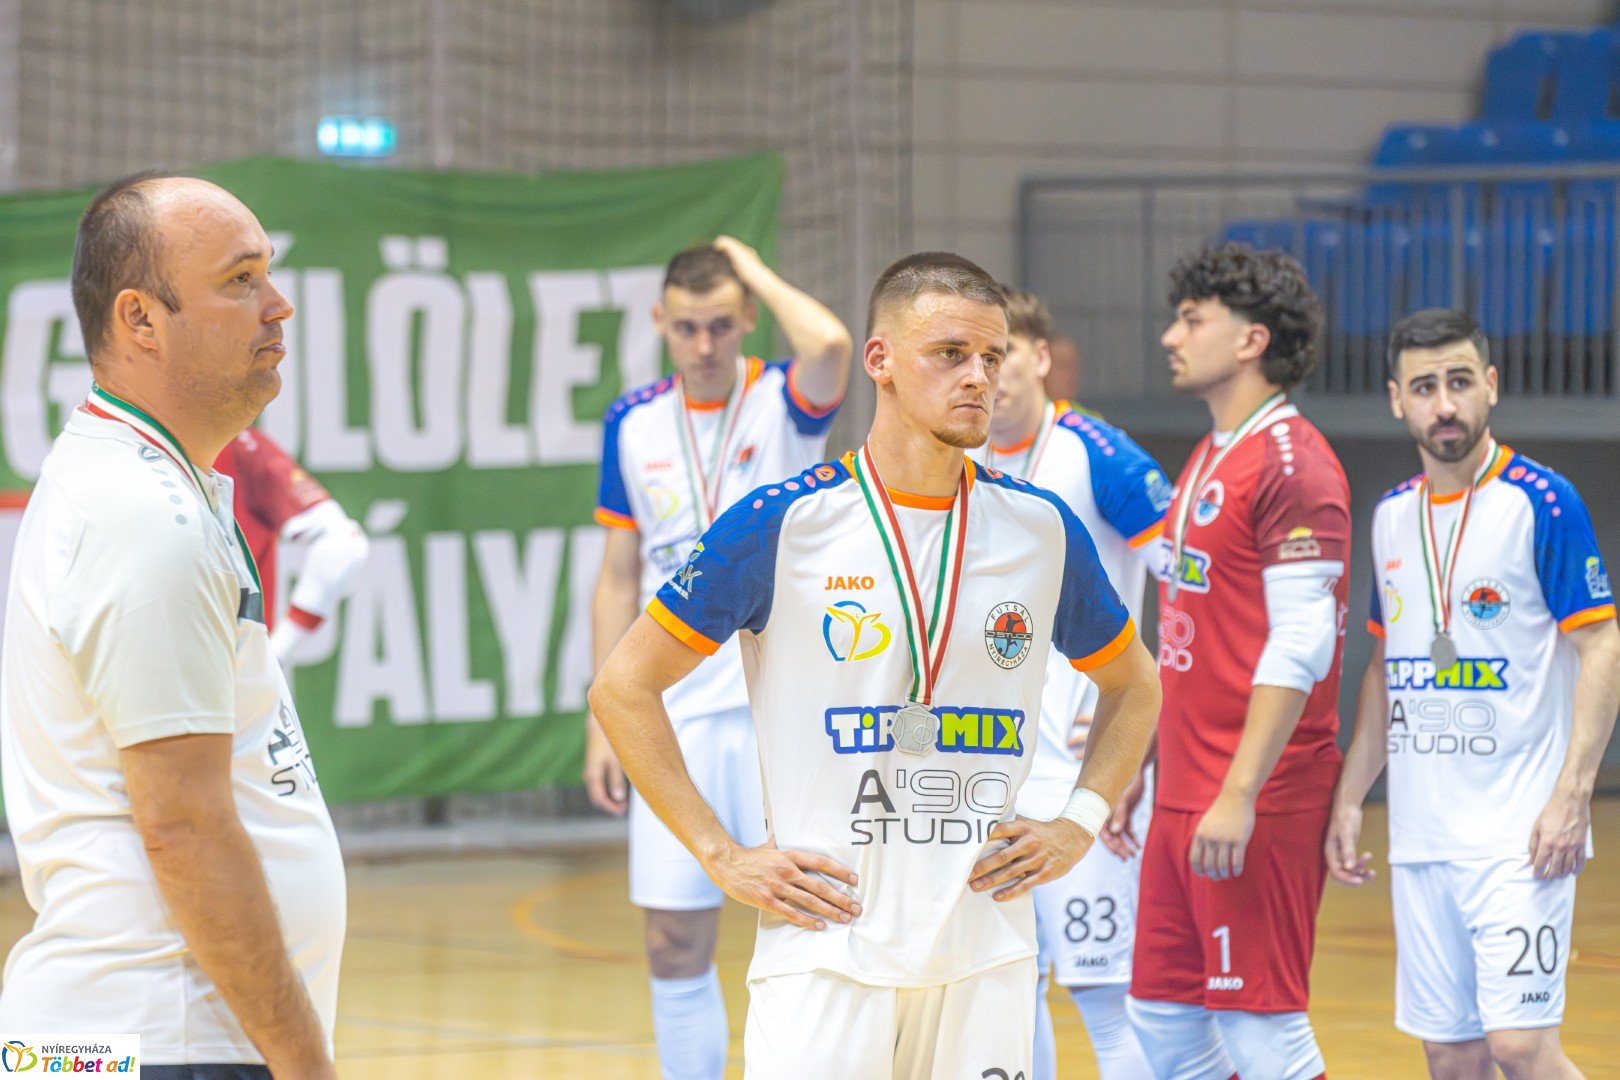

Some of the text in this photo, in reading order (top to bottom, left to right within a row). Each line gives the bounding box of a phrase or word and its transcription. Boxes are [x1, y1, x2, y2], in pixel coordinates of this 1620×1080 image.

[824, 576, 875, 590] JAKO
[991, 604, 1029, 623] FUTSAL
[825, 706, 1025, 757] TiPMIX
[1389, 699, 1497, 733] A'90
[850, 769, 1011, 815] A'90
[1065, 896, 1118, 943] 83
[1075, 955, 1108, 967] JAKO
[1212, 925, 1231, 973] 1
[1505, 925, 1557, 976] 20
[1207, 976, 1243, 990] JAKO
[1520, 991, 1550, 1003] JAKO
